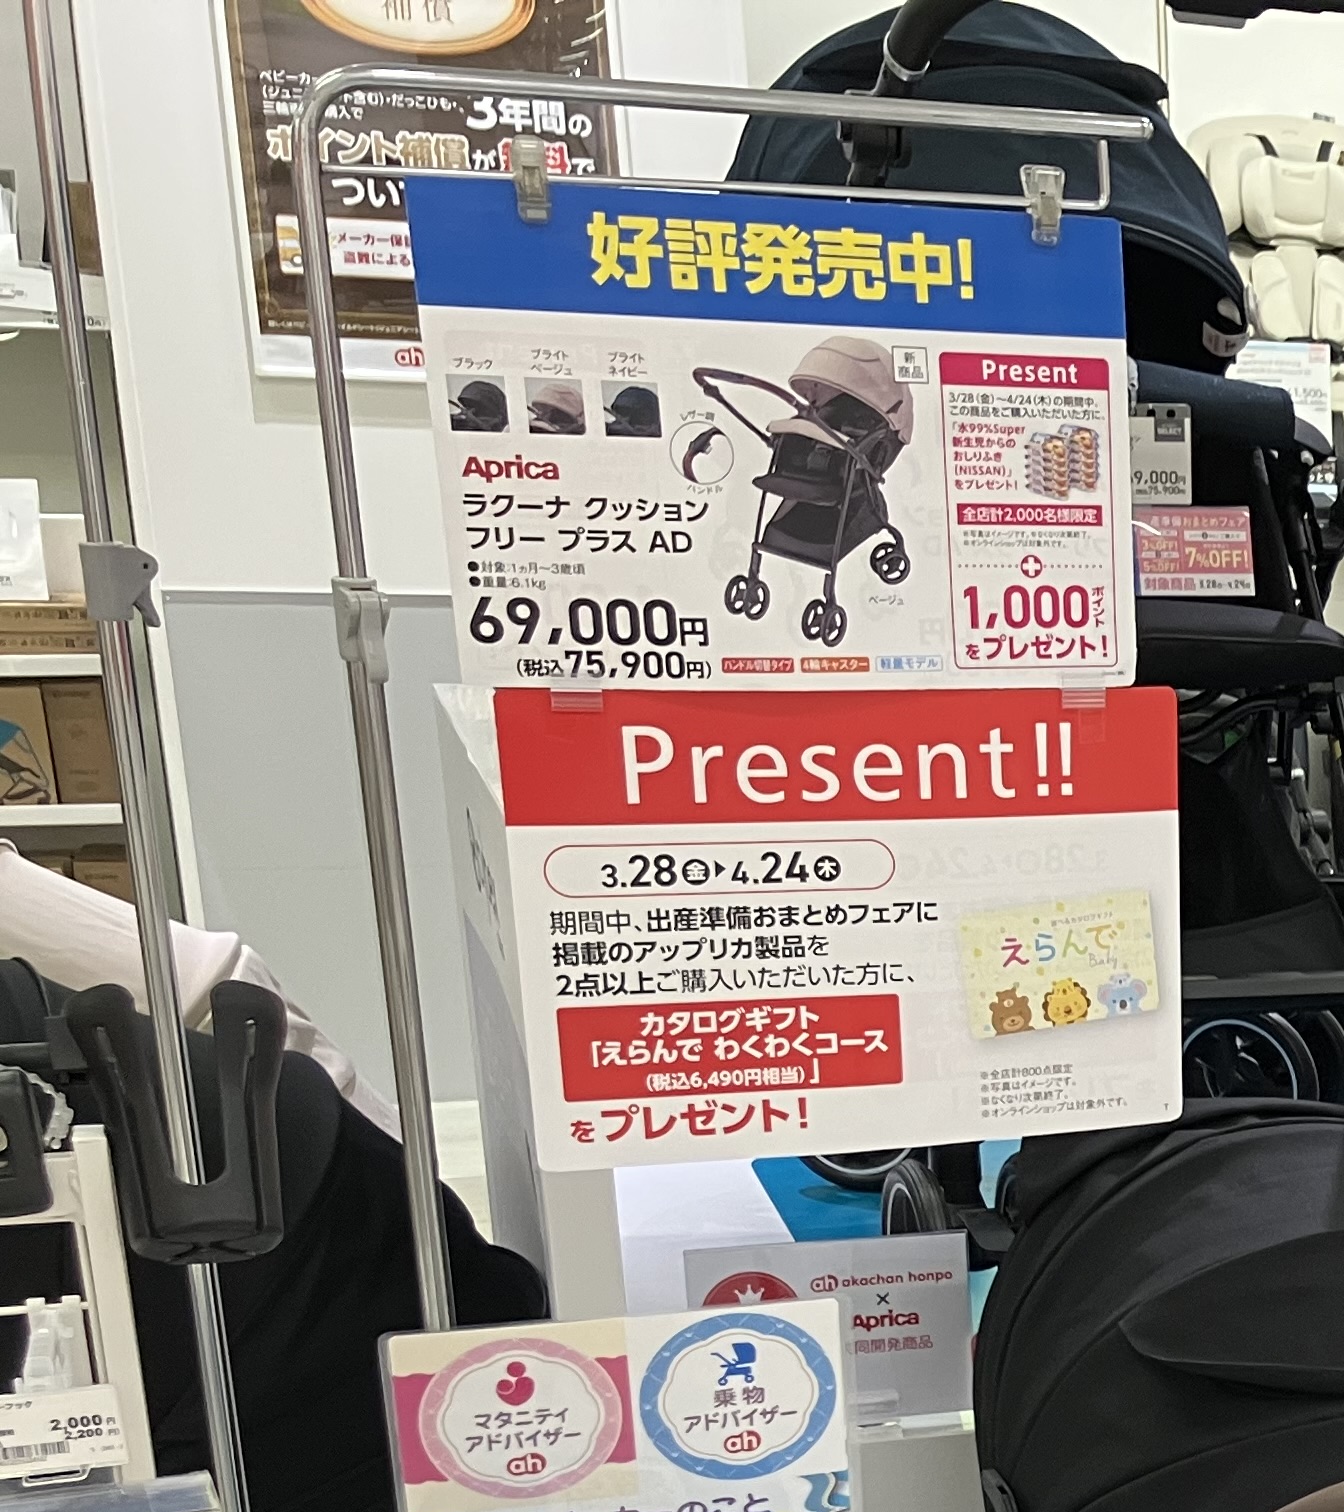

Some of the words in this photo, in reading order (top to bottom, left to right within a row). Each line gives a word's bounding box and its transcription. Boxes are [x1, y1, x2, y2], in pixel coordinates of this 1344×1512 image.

[588, 211, 975, 304] 好評発売中!
[452, 357, 493, 370] ブラック
[982, 361, 1079, 385] Present
[462, 454, 560, 483] Aprica
[463, 493, 571, 521] ラクーナ
[585, 496, 710, 523] クッション
[466, 526, 546, 551] フリー
[558, 526, 637, 554] プラス
[648, 530, 693, 553] AD
[469, 595, 710, 647] 69,000円
[962, 585, 1090, 631] 1,000
[620, 720, 1075, 805] Present!!
[552, 933, 832, 969] 掲載のアップリカ製品を
[640, 1005, 820, 1036] カタログギフト
[842, 1273, 905, 1289] akachan
[907, 1268, 954, 1286] honpo
[851, 1308, 920, 1332] Aprica
[473, 1407, 569, 1431] マタニティ
[684, 1406, 798, 1433] アドバイザー
[465, 1428, 582, 1454] アドバイザー
